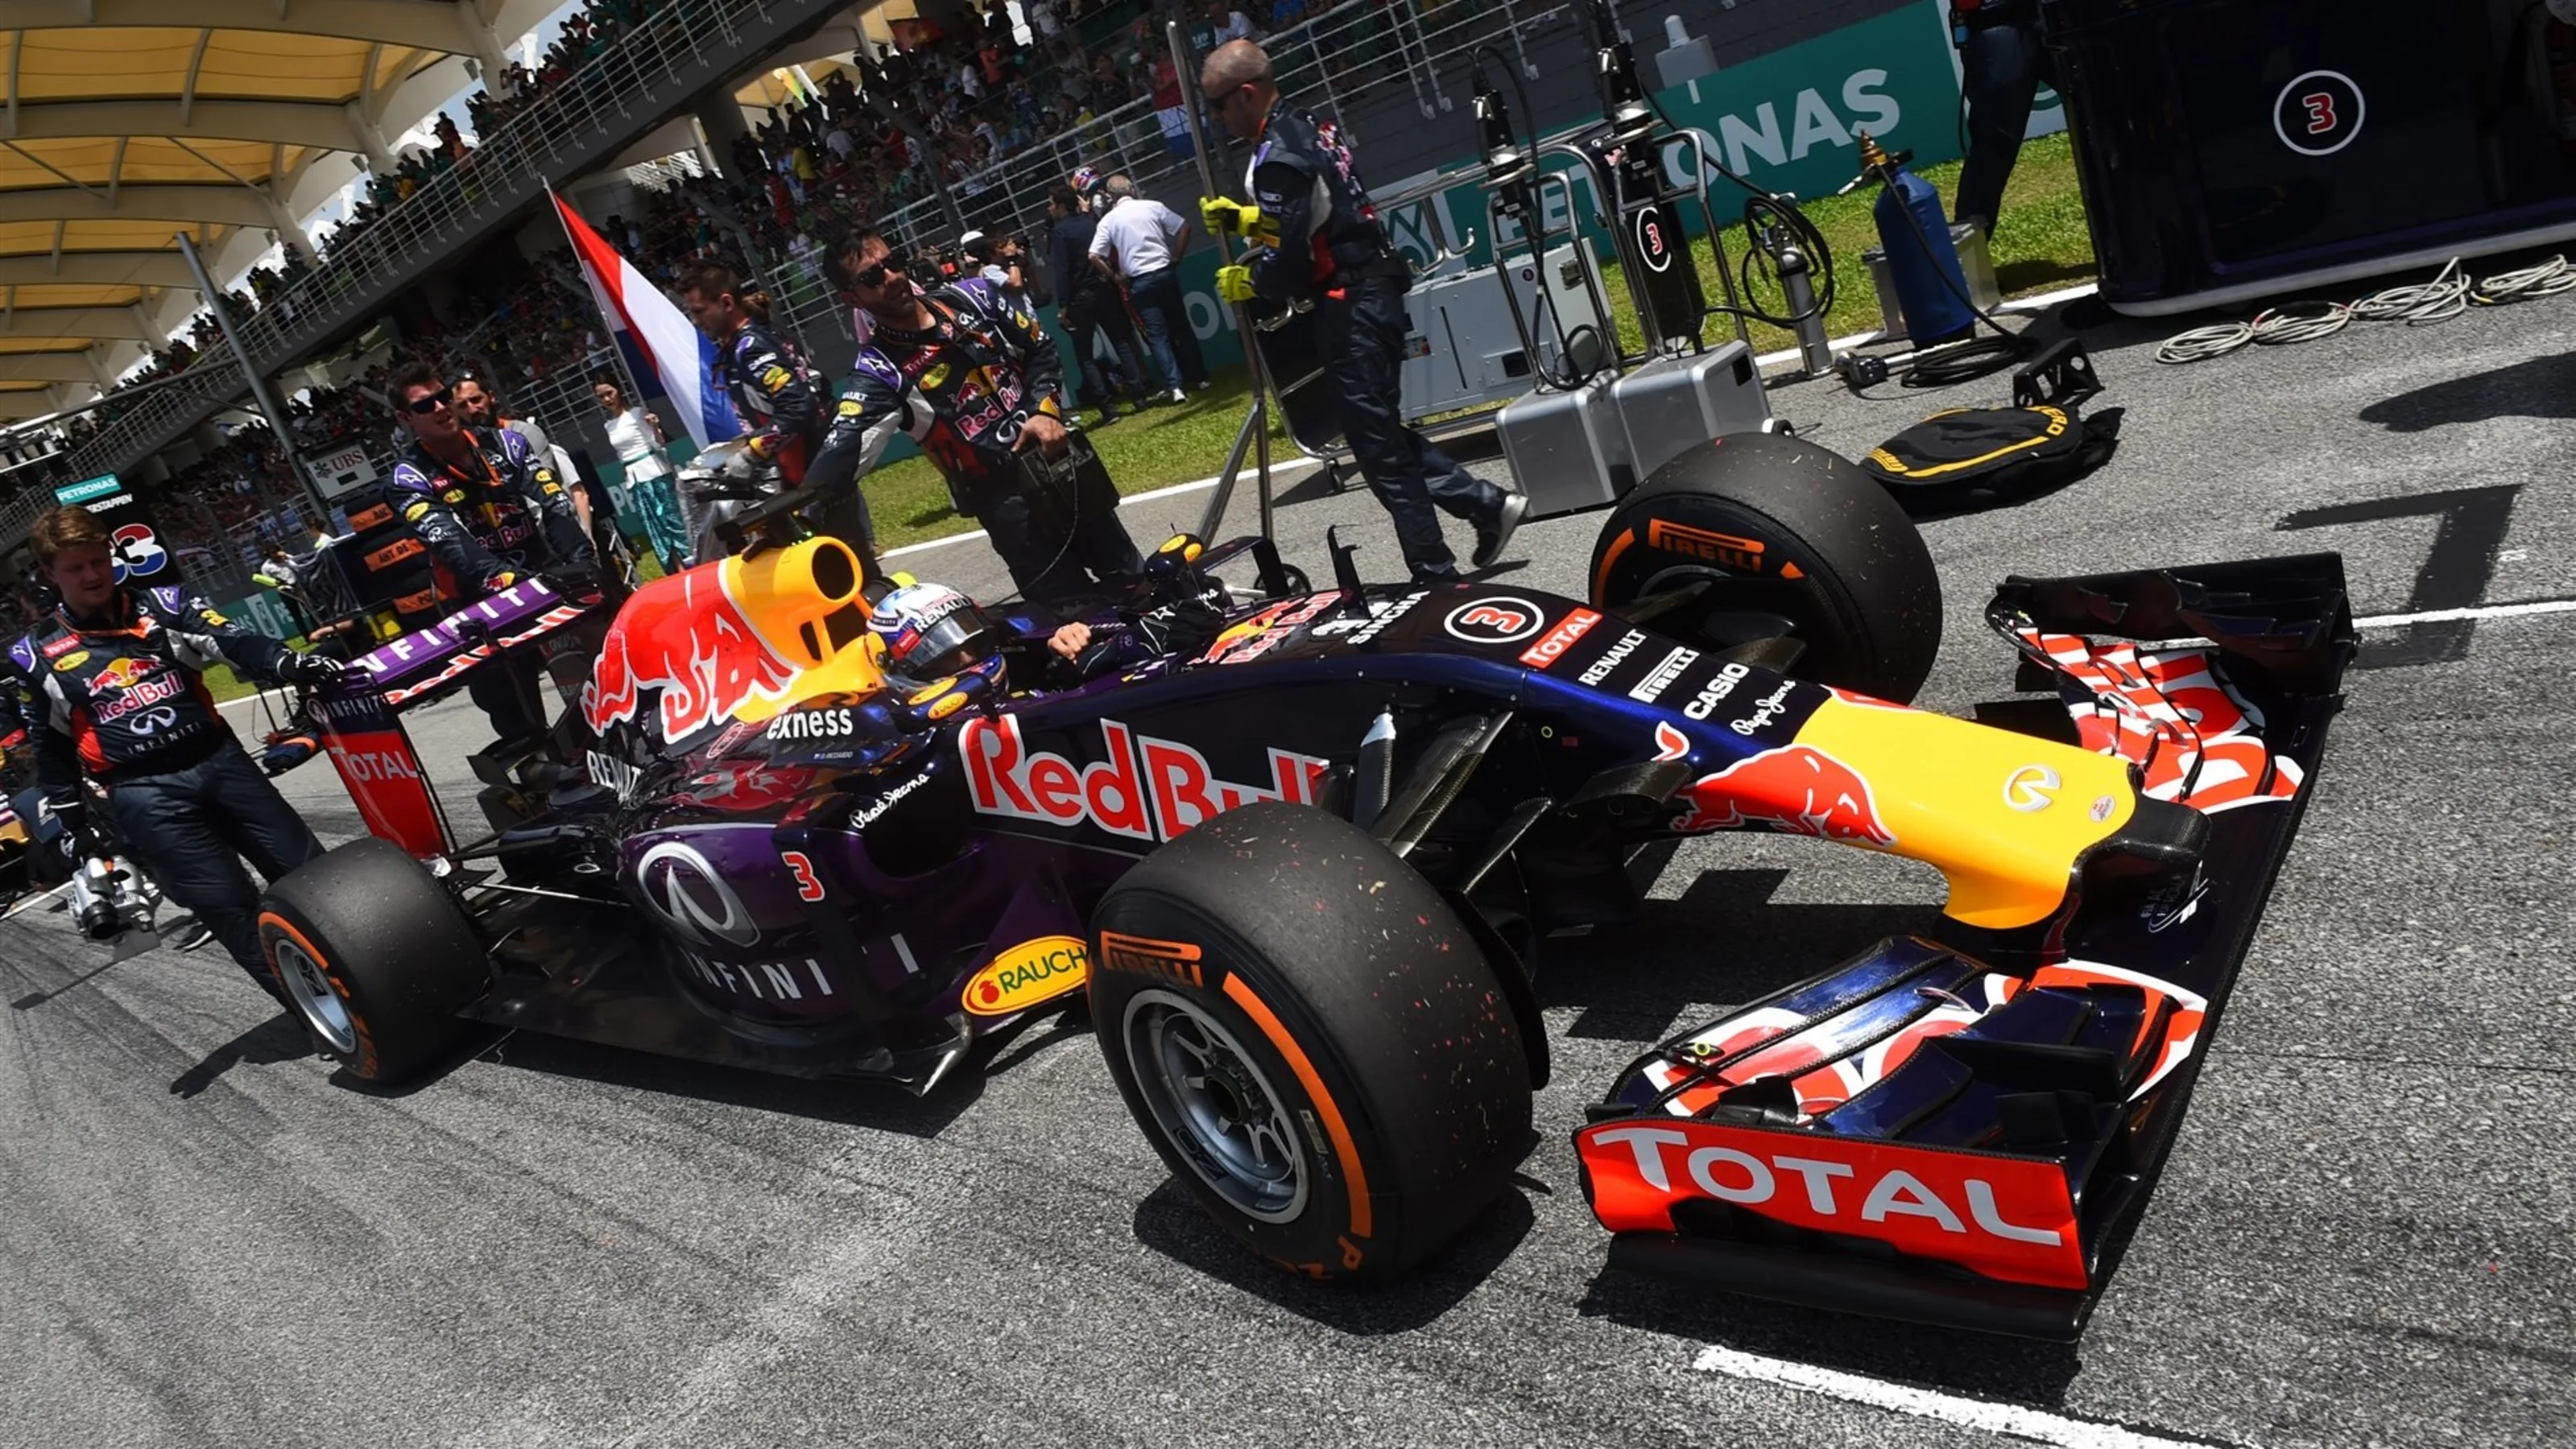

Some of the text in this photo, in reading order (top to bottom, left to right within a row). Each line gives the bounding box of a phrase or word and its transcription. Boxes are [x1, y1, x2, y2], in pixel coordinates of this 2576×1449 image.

[2302, 92, 2337, 134] 3
[1488, 68, 1900, 242] ETONAS
[1645, 222, 1664, 256] 3
[955, 396, 1004, 441] Red
[998, 370, 1023, 411] Bull
[330, 450, 364, 472] UBS
[57, 477, 118, 502] PETRONAS
[85, 493, 133, 514] RSTAPPEN
[1648, 518, 1765, 572] PIRELLI
[353, 578, 550, 673] NFINITI
[1219, 591, 1342, 664] Red Bull
[1347, 591, 1430, 644] SINGHA
[1460, 606, 1527, 633] 3
[1524, 613, 1600, 663] TOTAL
[1578, 629, 1648, 686] RENAULT
[1628, 646, 1701, 704] PIRELLI
[92, 669, 185, 724] Red Bull
[1683, 663, 1751, 720] CASIO
[1755, 680, 1797, 714] Jeans
[128, 721, 201, 755] INFINITI
[767, 708, 854, 739] exness
[329, 749, 419, 782] TOTAL
[958, 713, 1153, 841] Red
[782, 851, 825, 902] 3
[678, 933, 920, 1000] INFINII
[999, 947, 1086, 994] RAUCH
[1101, 931, 1204, 989] PIRELLI
[1592, 1127, 2061, 1246] TOTAL
